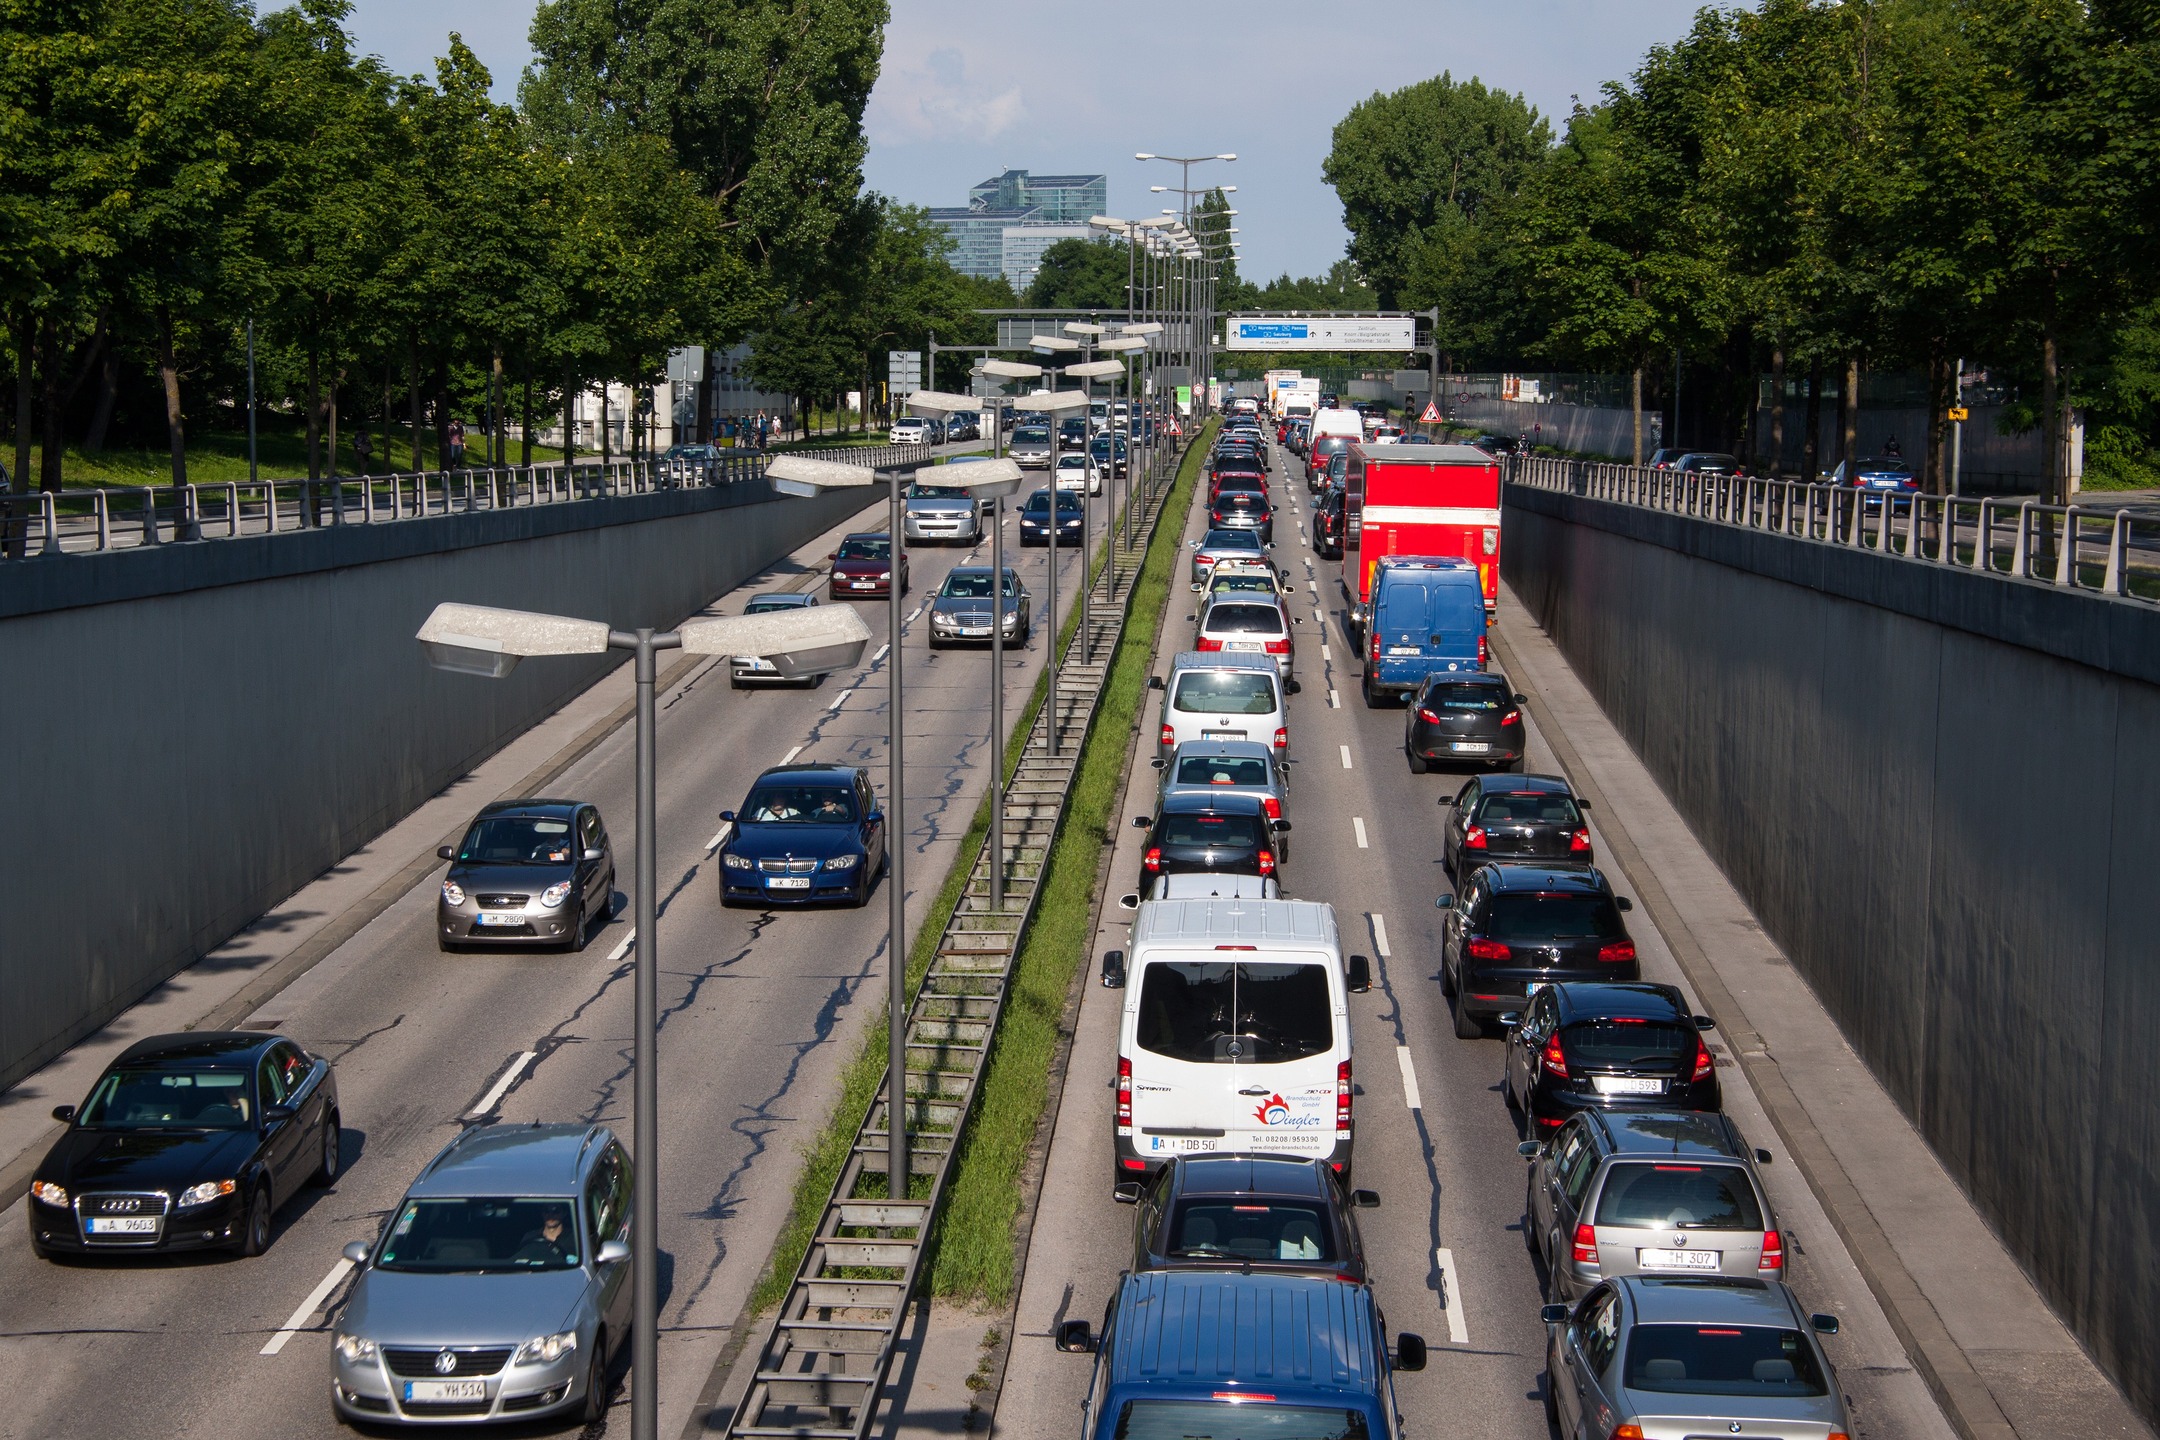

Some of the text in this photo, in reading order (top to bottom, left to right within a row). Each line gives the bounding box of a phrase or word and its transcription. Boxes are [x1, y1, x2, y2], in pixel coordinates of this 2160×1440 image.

[1638, 1080, 1658, 1091] 593
[1268, 1107, 1321, 1130] Dingler
[1252, 1135, 1319, 1143] Tel. 08208/959390
[1186, 1139, 1200, 1150] DB
[1201, 1140, 1215, 1151] 50
[125, 1220, 154, 1231] 9603
[1688, 1252, 1711, 1265] 307
